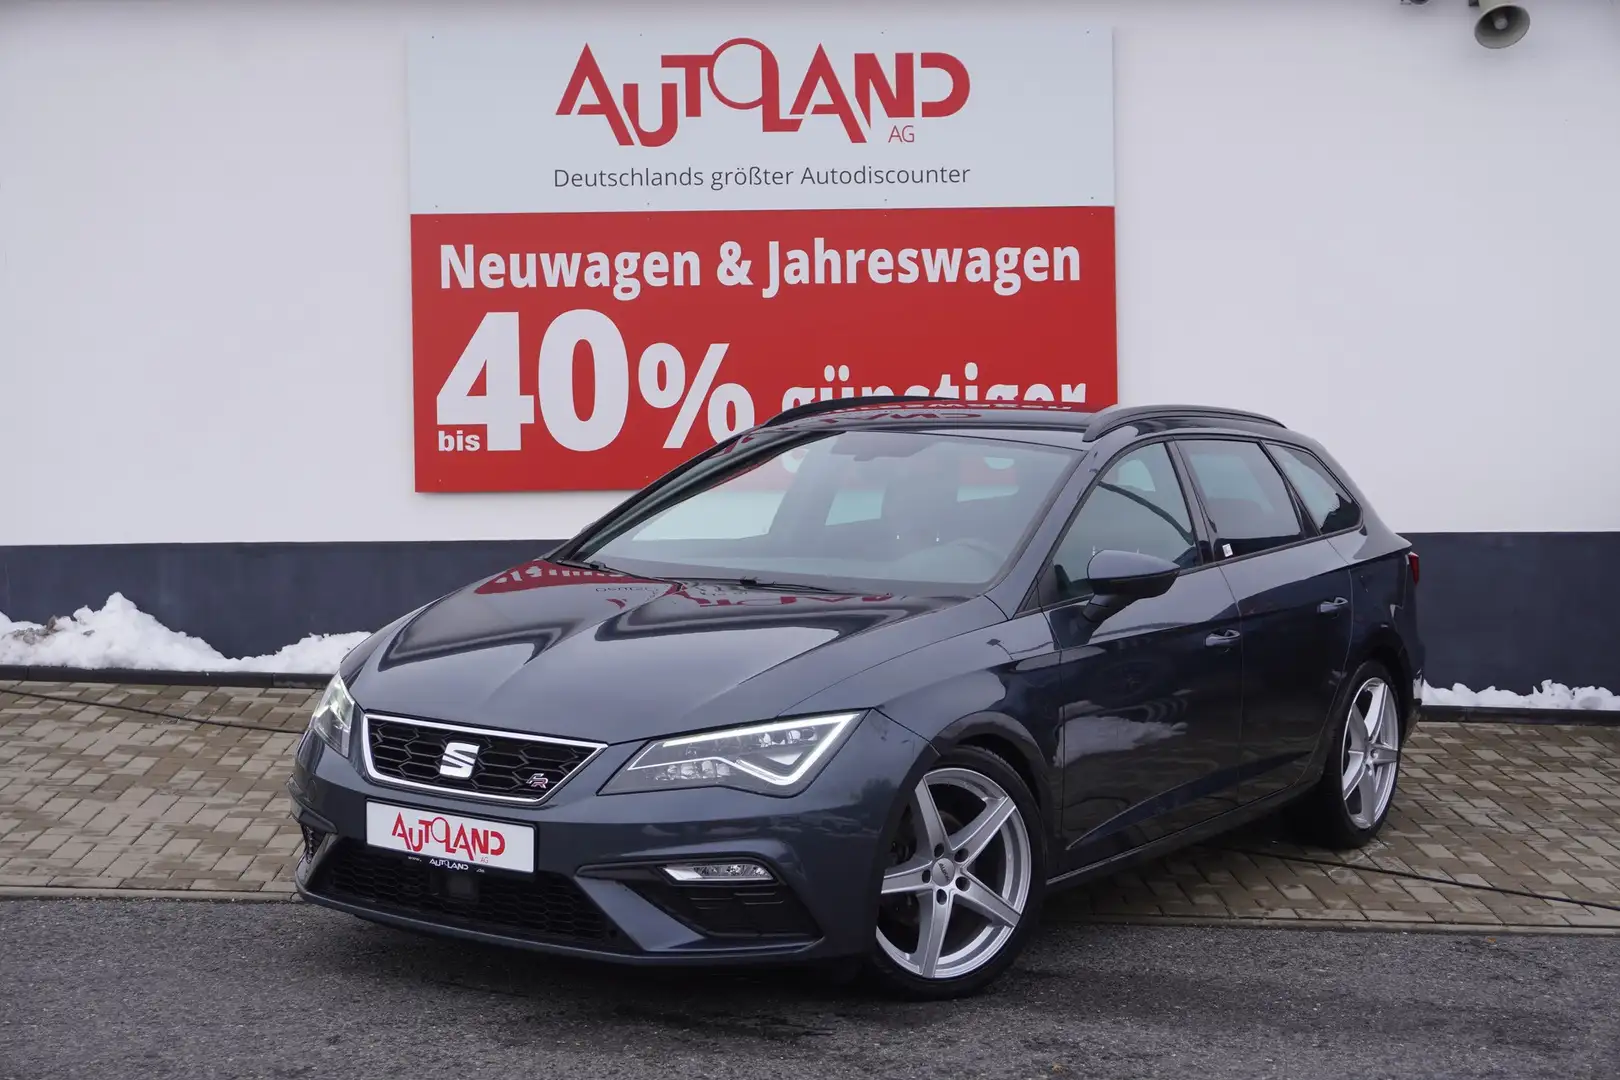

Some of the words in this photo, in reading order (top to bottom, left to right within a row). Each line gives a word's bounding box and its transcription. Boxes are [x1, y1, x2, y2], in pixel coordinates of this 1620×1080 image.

[556, 38, 970, 147] AUTOLAND
[888, 126, 915, 143] AG
[554, 167, 704, 188] Deutschlands
[711, 167, 795, 191] größter
[801, 165, 971, 186] Autodiscounter
[440, 243, 701, 301] Neuwagen
[716, 241, 753, 286] &
[762, 237, 1081, 299] Jahreswagen
[438, 429, 481, 452] bis
[391, 811, 506, 861] AUTOLAND
